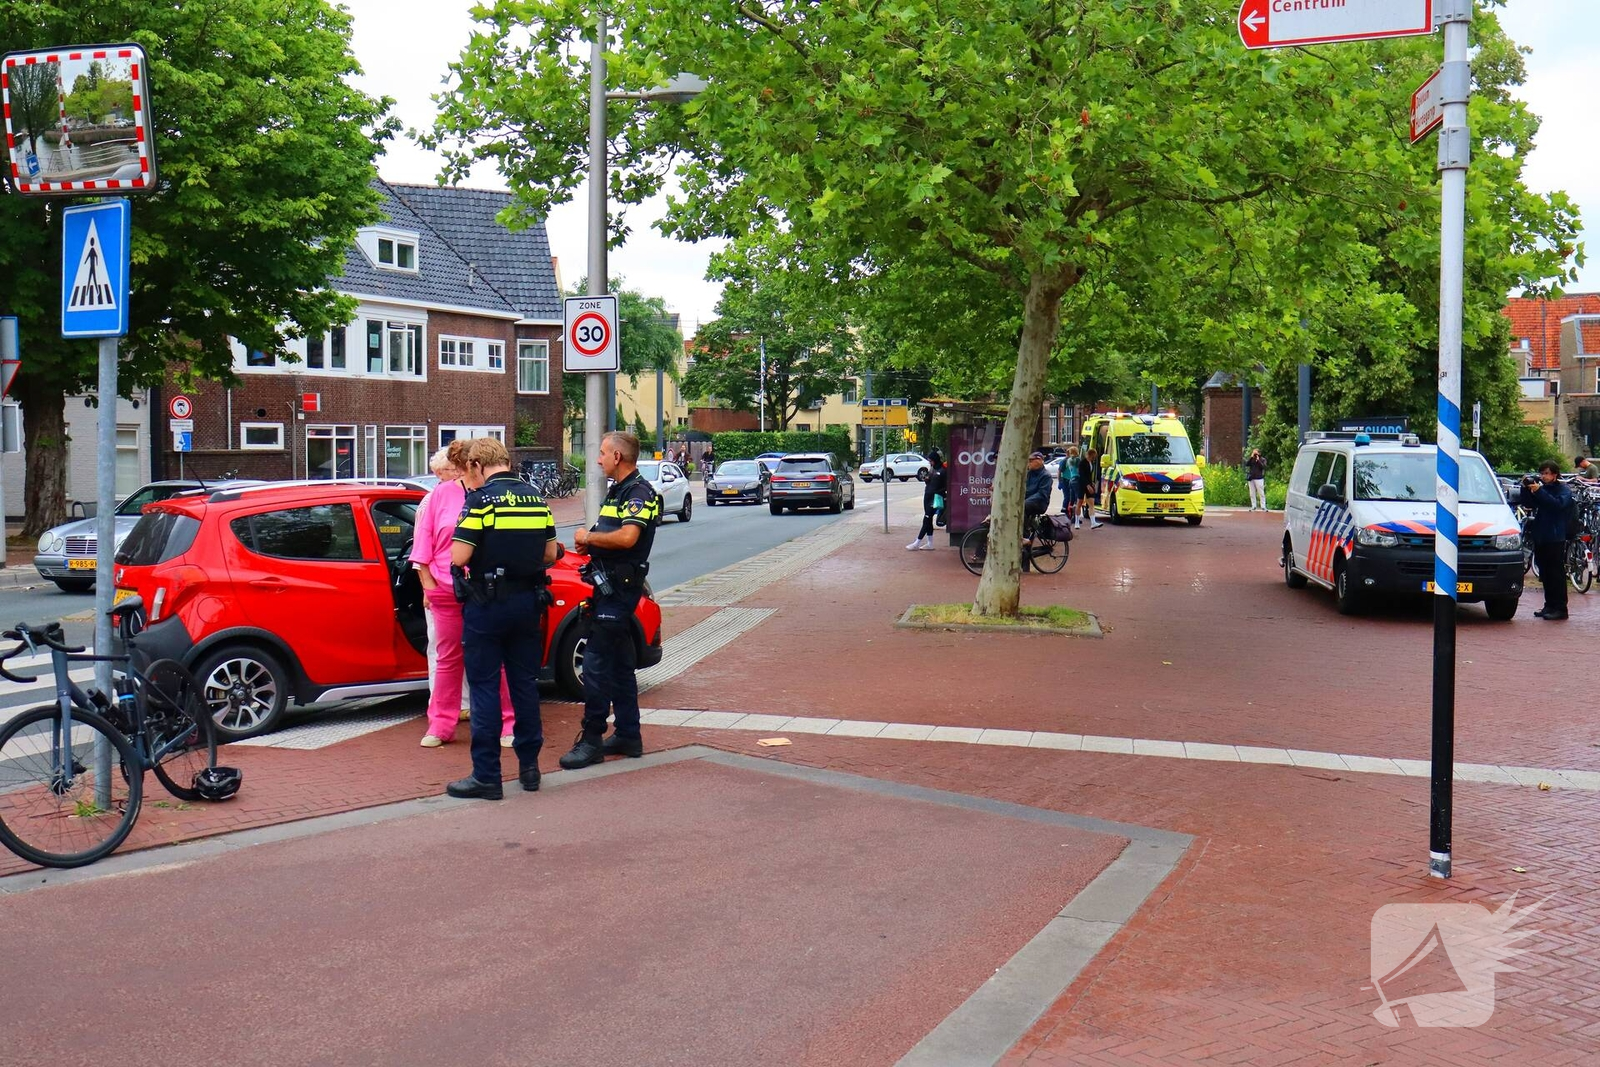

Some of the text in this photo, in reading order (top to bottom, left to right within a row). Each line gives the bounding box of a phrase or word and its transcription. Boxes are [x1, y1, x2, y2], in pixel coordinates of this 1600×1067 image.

[1272, 0, 1346, 13] Centrum
[579, 302, 602, 310] ZONE
[578, 326, 604, 342] 30
[960, 486, 969, 496] je
